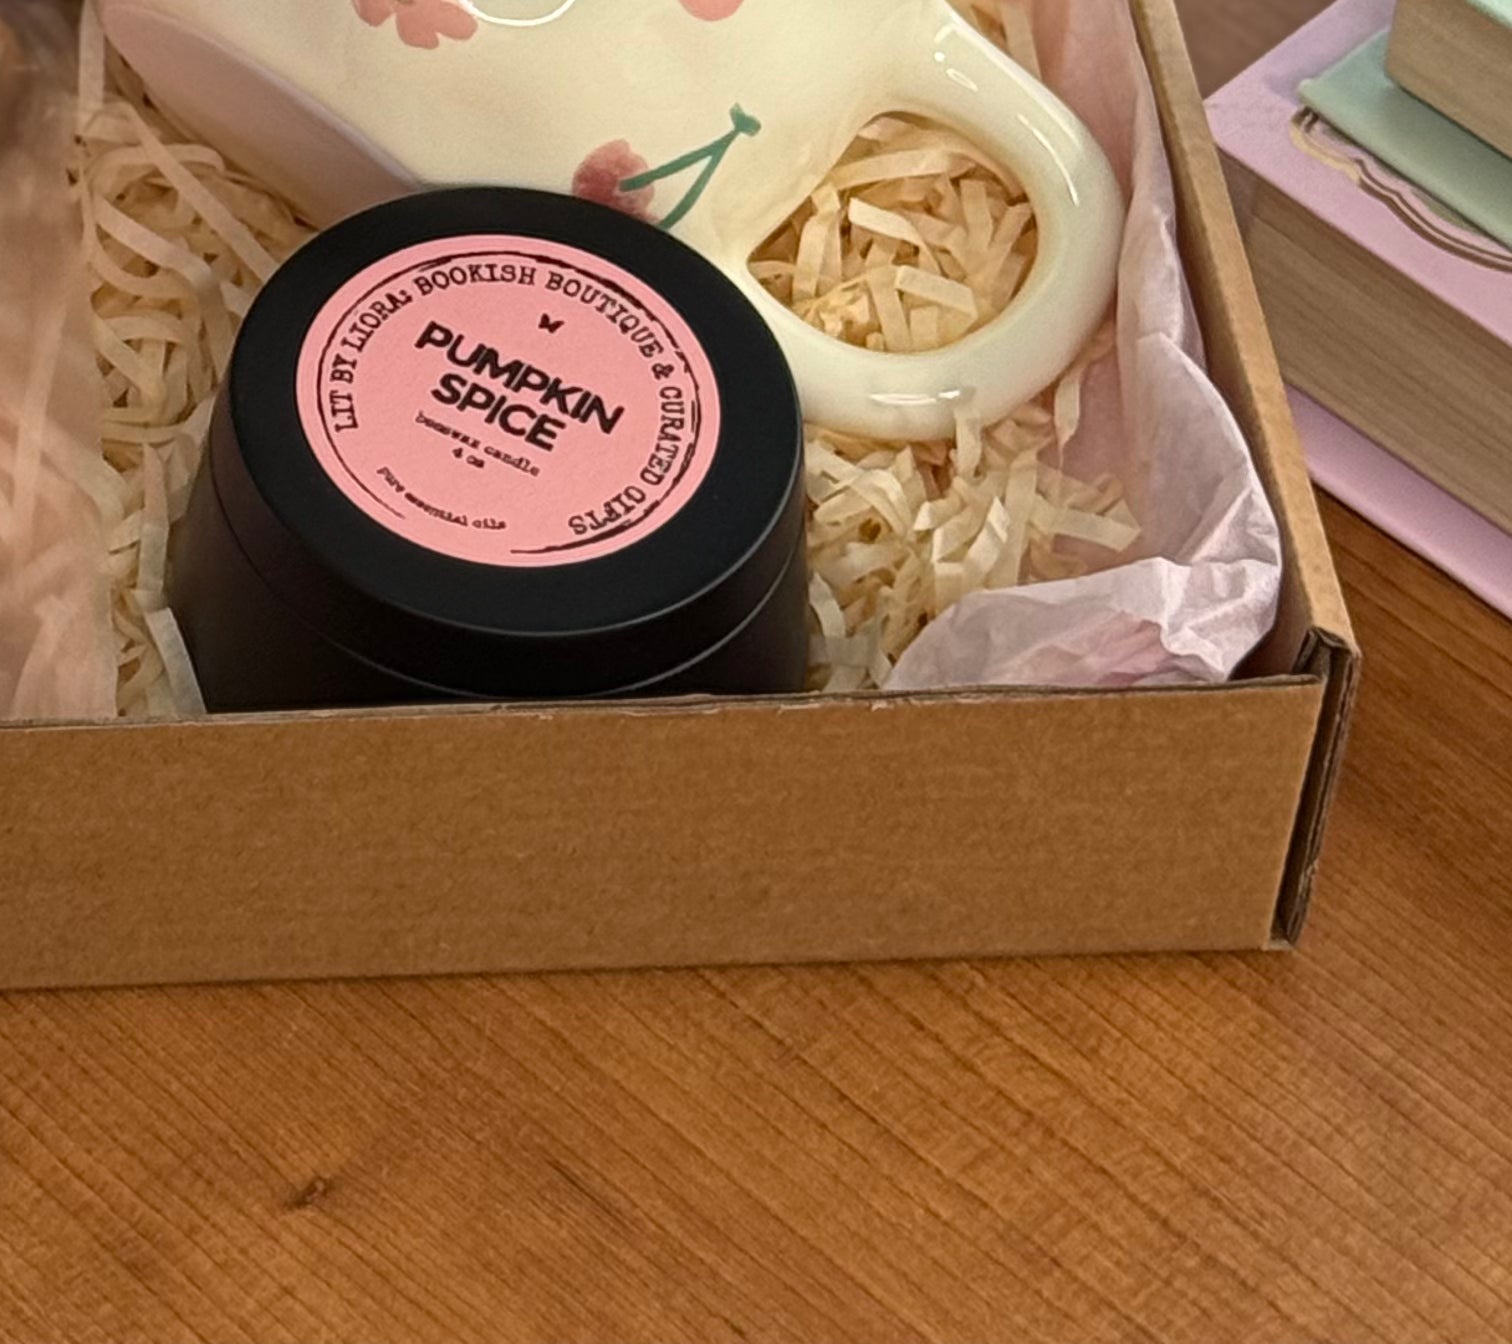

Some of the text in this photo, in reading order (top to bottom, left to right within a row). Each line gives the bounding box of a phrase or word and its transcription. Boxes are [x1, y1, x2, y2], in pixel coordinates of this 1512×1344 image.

[329, 263, 685, 536] LIT BY LIORA: BOOKISH BOUTIQUE & CURATED GIFTS
[414, 320, 625, 434] PUMPKIN
[430, 372, 567, 452] SPICE
[415, 410, 541, 477] beeswax candle
[451, 447, 464, 459] 4
[404, 492, 469, 527] essential
[471, 517, 507, 531] oils
